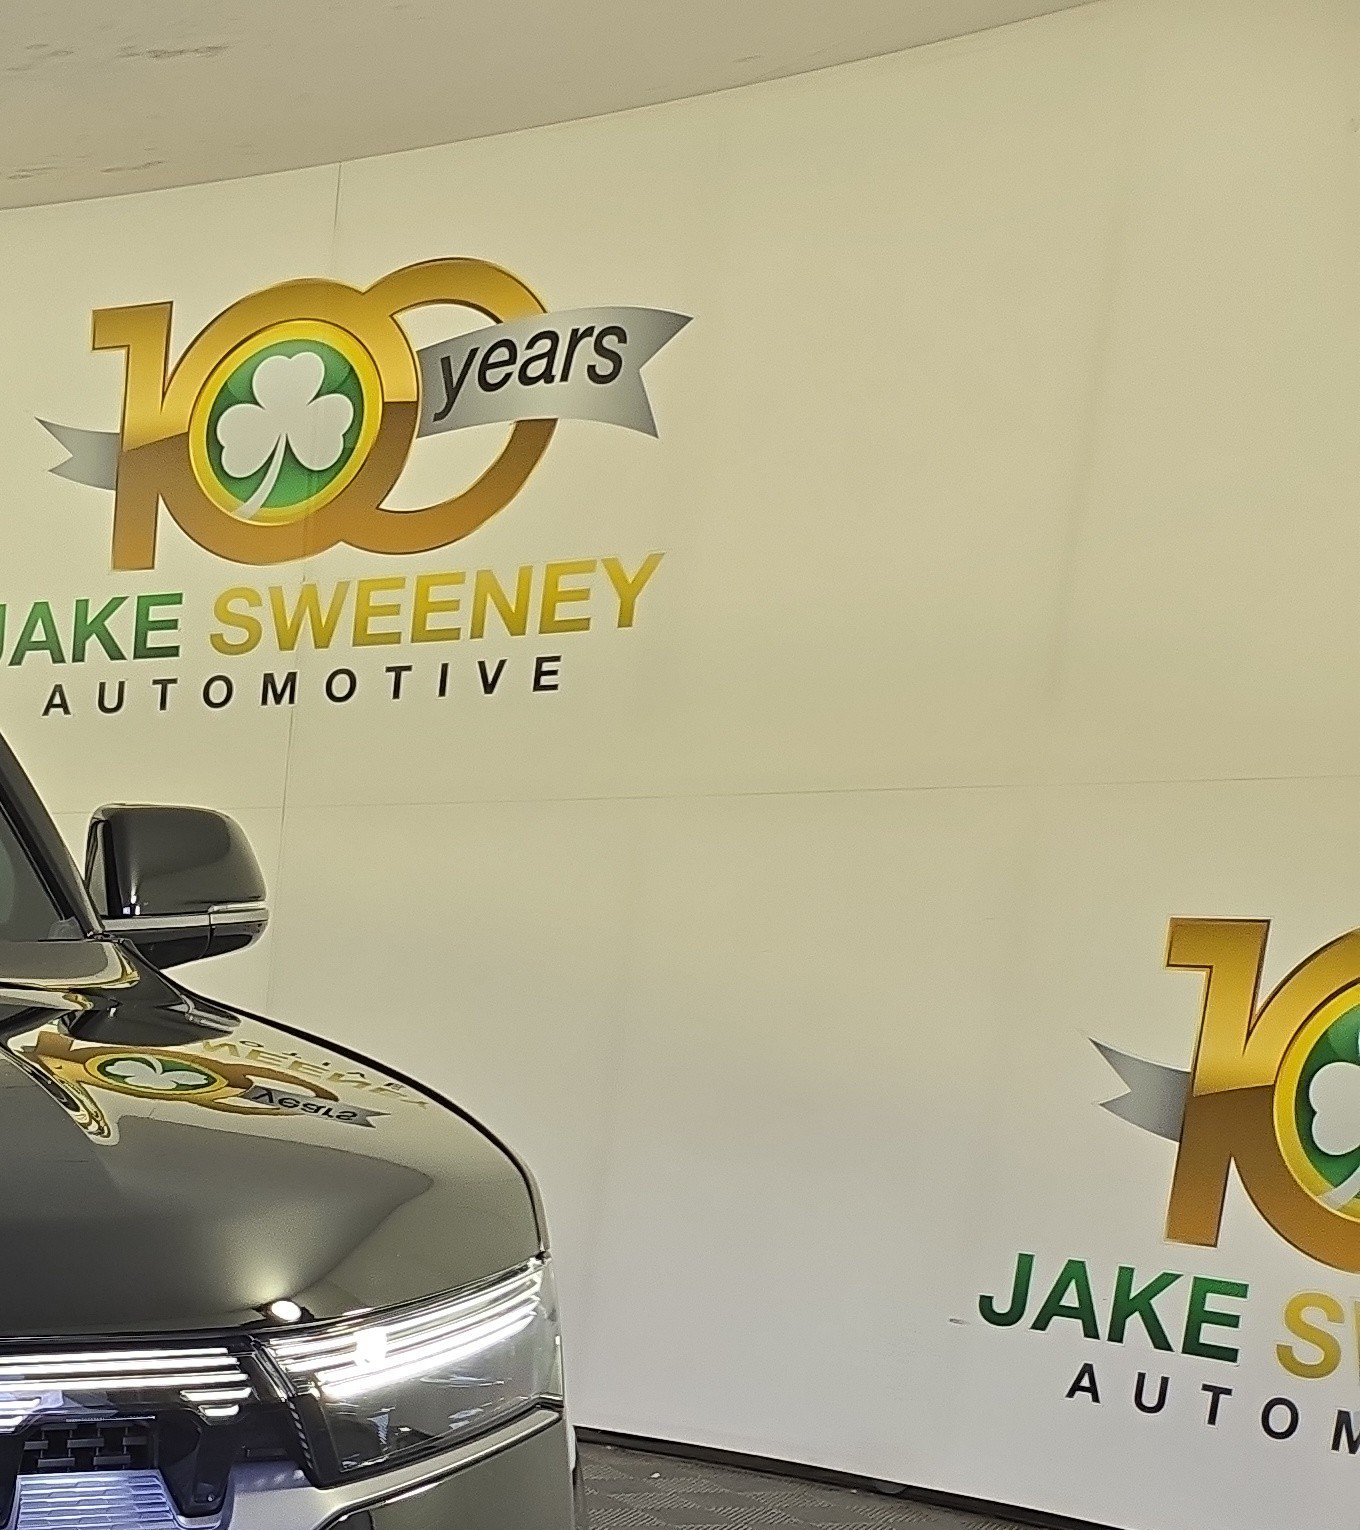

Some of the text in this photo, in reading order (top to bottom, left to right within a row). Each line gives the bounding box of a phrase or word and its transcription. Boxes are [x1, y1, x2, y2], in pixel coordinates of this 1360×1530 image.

[432, 324, 629, 423] years
[209, 551, 666, 657] SWEENEY
[42, 654, 563, 718] AUTOMOTIVE
[978, 1252, 1360, 1380] JAKE S
